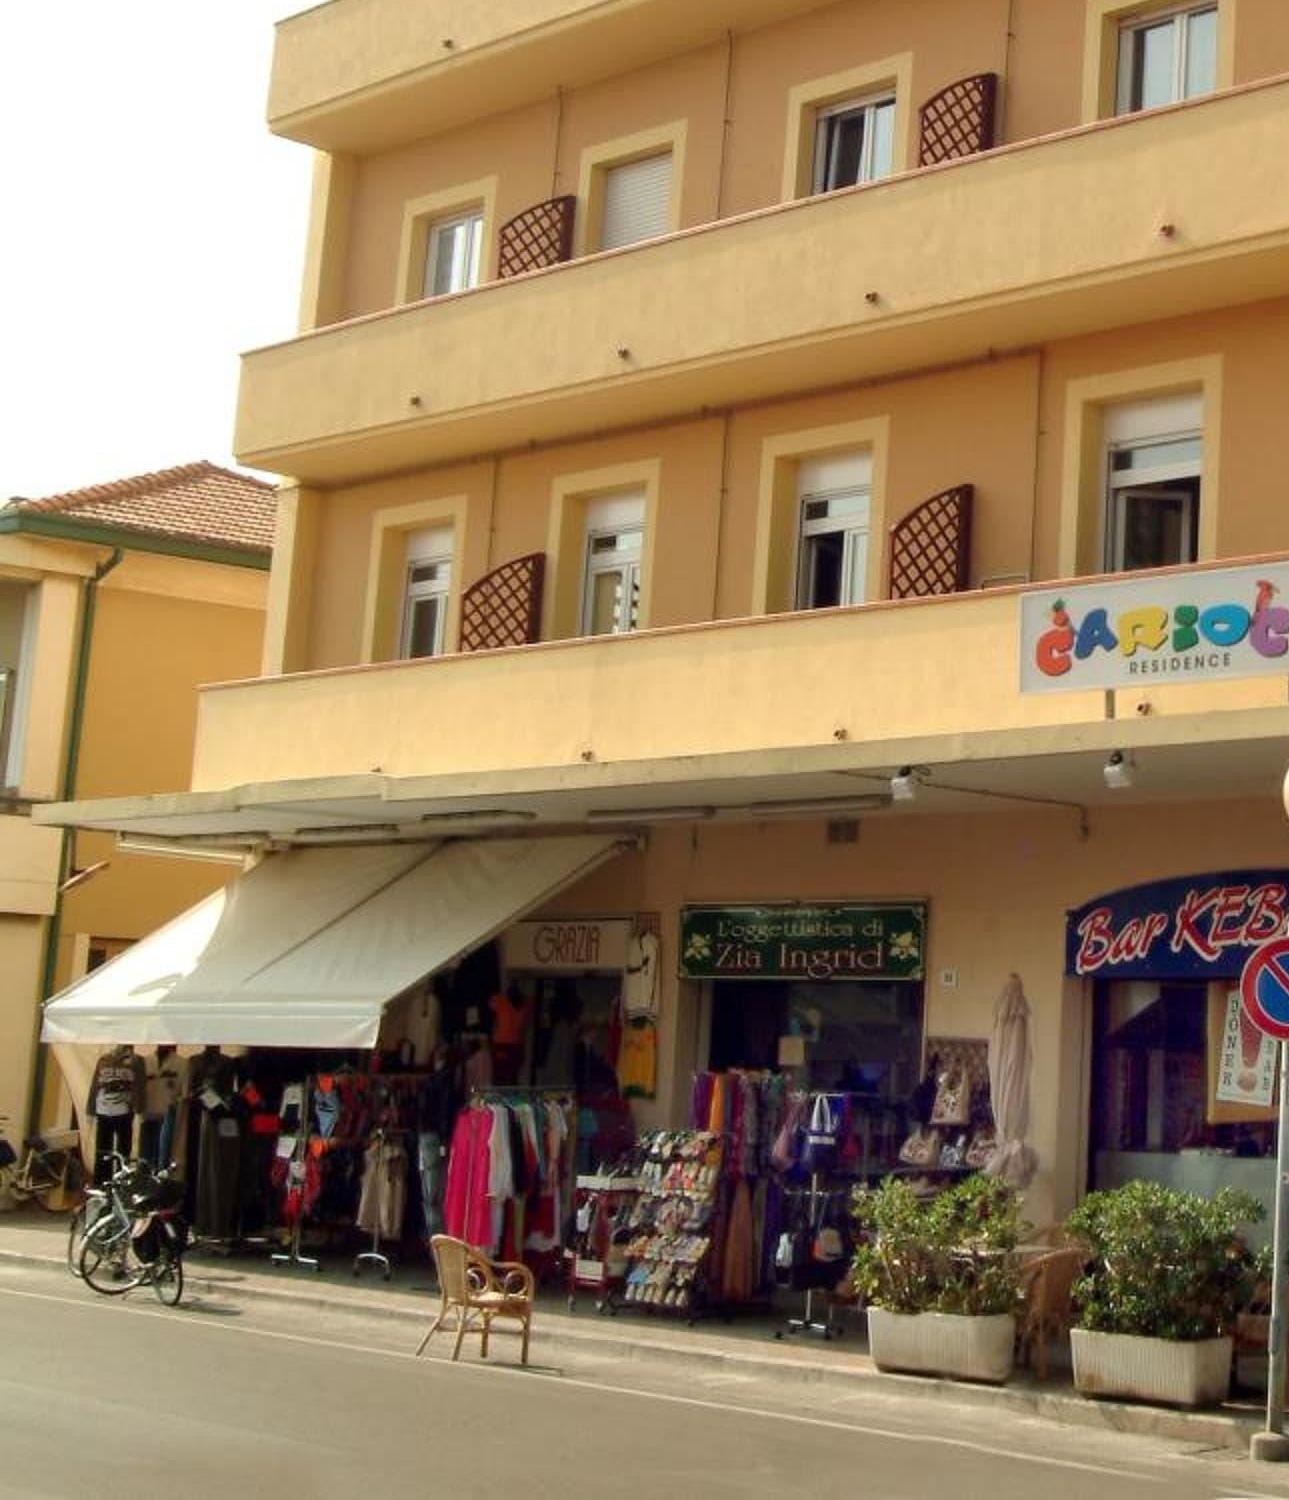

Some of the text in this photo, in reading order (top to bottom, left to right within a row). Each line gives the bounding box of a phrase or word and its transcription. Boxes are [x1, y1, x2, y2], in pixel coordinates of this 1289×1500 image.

[1129, 652, 1231, 675] RESIDENCE
[533, 925, 600, 964] GRAZIA
[862, 918, 883, 938] di
[1075, 906, 1168, 975] Bar
[715, 941, 883, 978] Zia Ingrid
